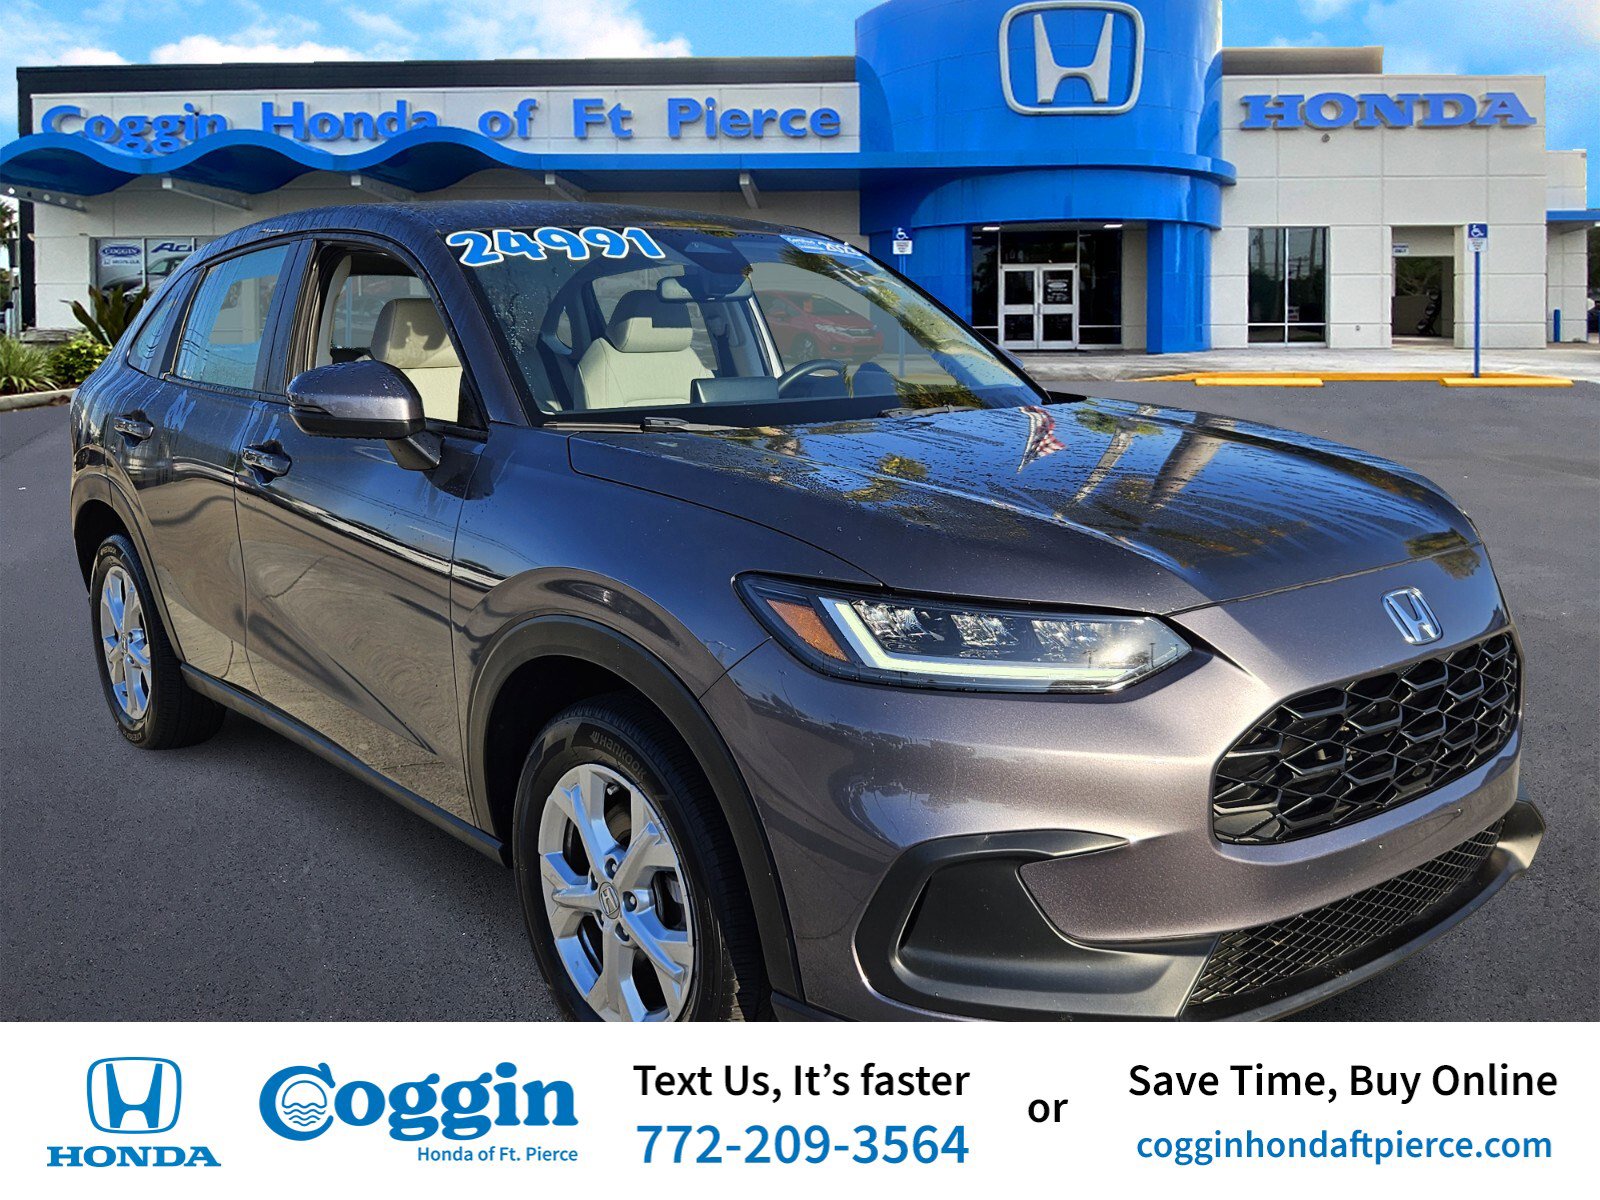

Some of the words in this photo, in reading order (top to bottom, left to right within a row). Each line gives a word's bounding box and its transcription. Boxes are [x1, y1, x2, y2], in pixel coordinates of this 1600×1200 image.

[41, 102, 229, 154] Coggin
[261, 99, 440, 141] Honda
[478, 98, 540, 139] of
[573, 97, 634, 140] Ft
[667, 96, 842, 139] Pierce
[1239, 91, 1538, 130] HONDA
[446, 226, 666, 267] 24991
